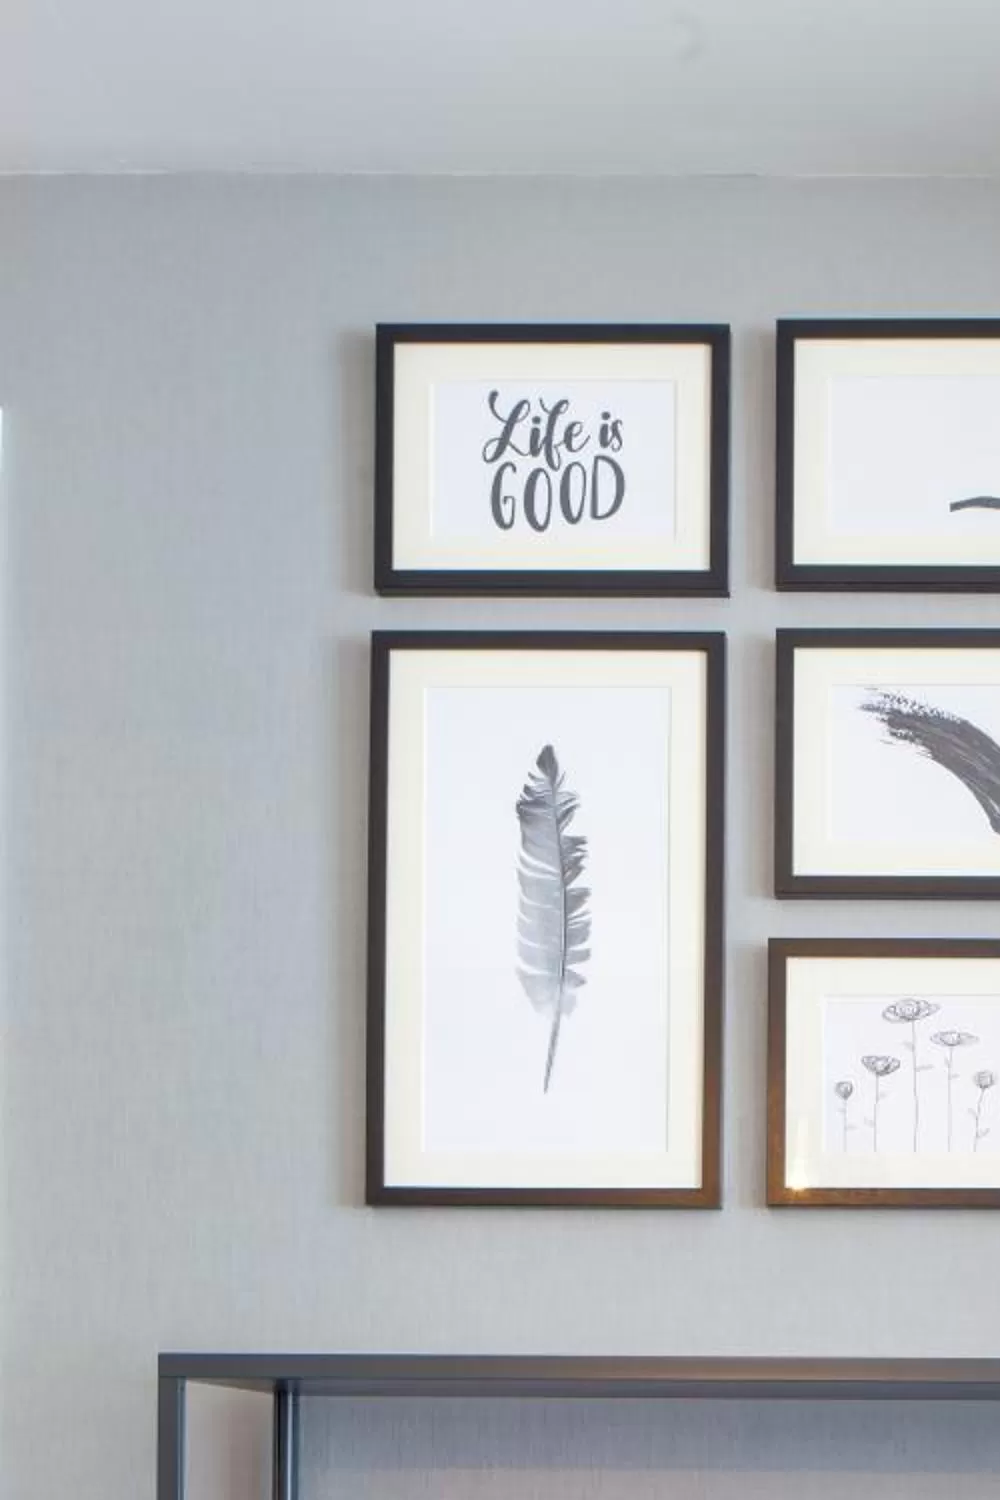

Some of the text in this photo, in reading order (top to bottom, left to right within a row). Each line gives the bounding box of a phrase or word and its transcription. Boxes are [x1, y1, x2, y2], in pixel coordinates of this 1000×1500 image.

[482, 389, 624, 472] Life is
[490, 454, 626, 533] GOOD
